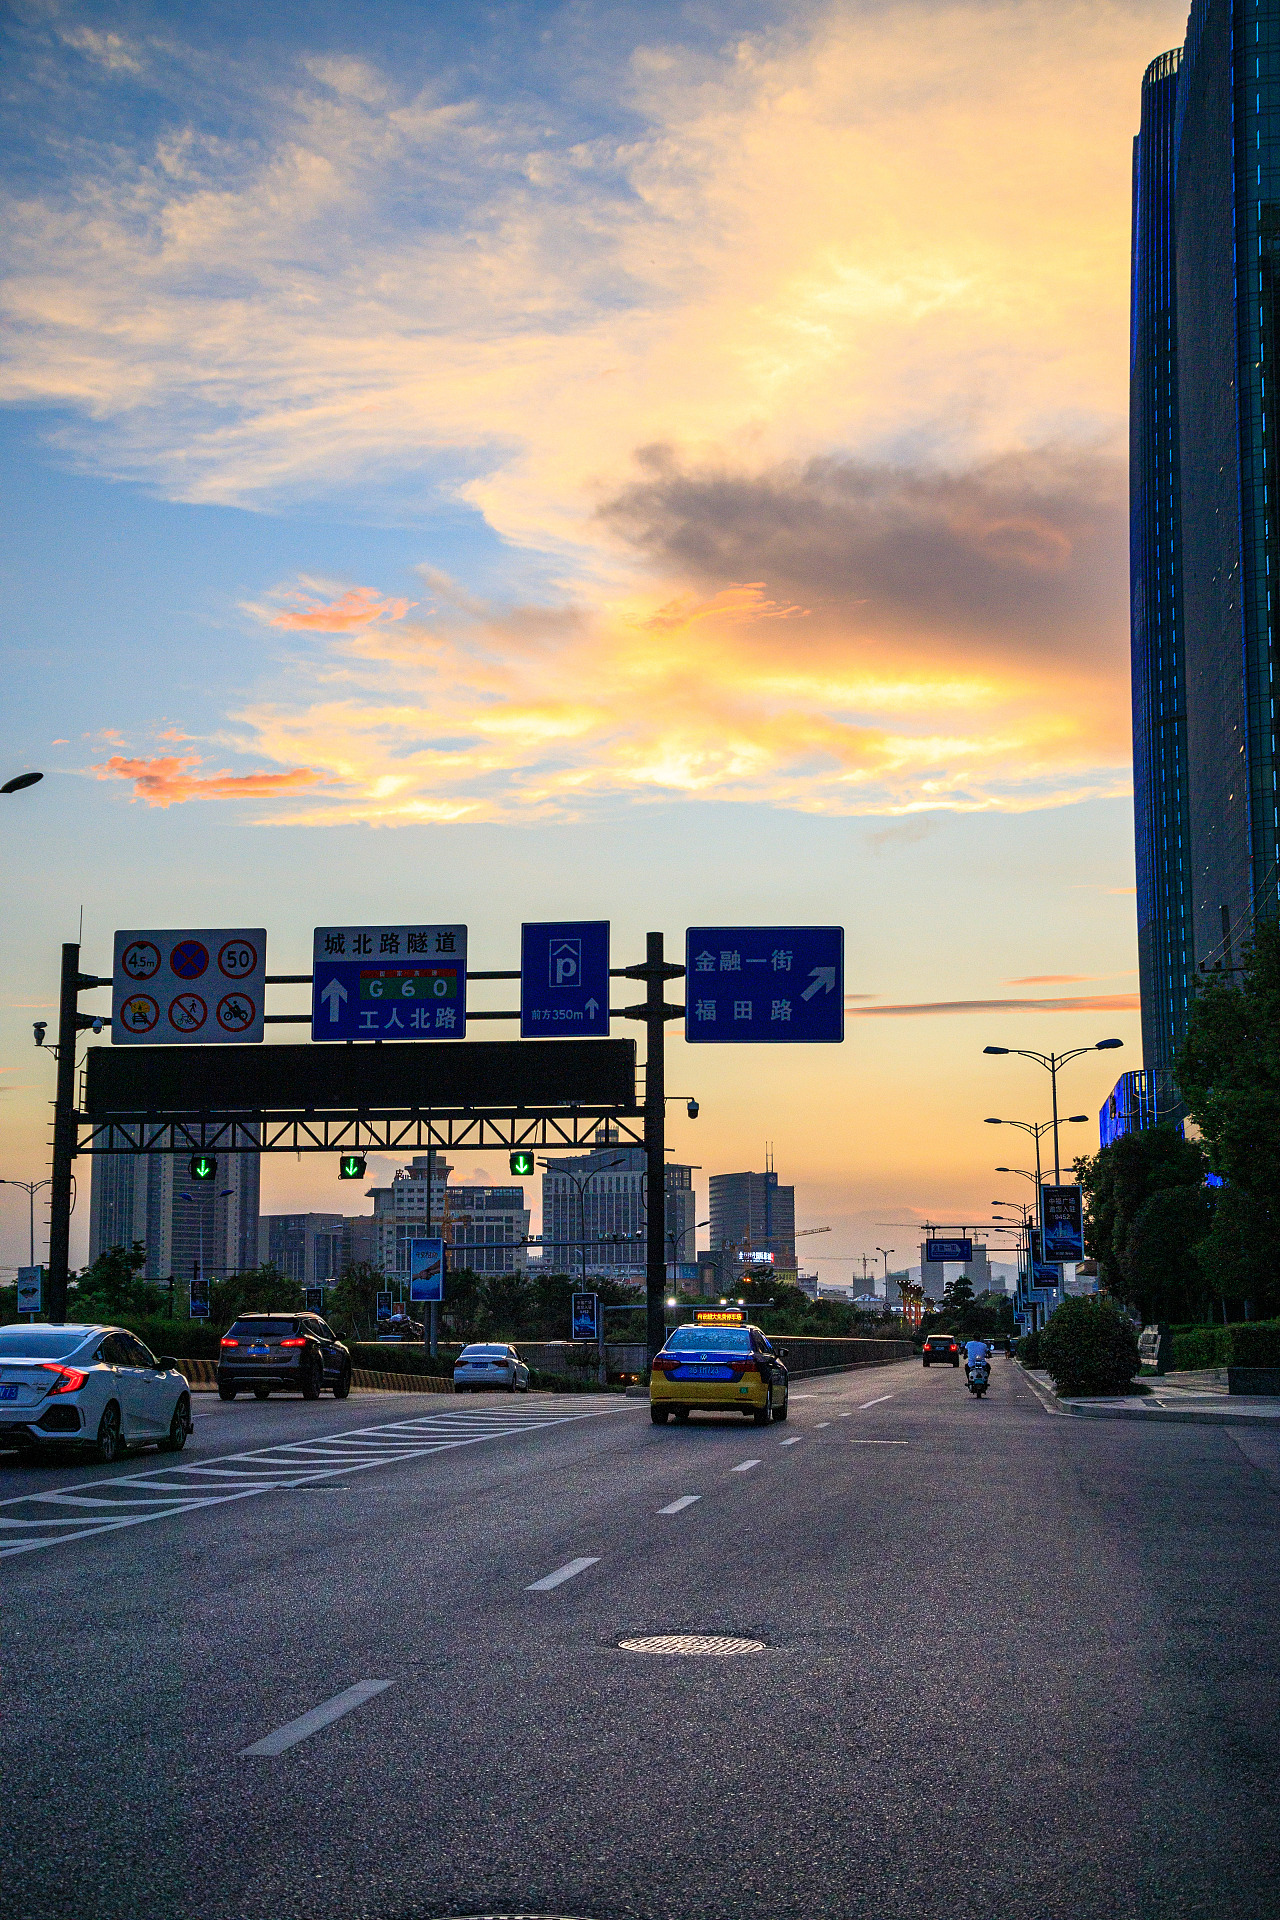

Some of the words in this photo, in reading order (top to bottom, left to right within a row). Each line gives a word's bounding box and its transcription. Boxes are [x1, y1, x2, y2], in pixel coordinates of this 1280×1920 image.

[324, 932, 457, 955] 城北路隧道
[128, 952, 155, 968] 4.5m
[227, 950, 250, 969] 50
[695, 950, 793, 972] 金融一街
[369, 979, 448, 998] G60
[358, 1007, 457, 1030] 工人北路
[531, 1009, 584, 1020] 前方350m
[695, 999, 793, 1022] 福田路
